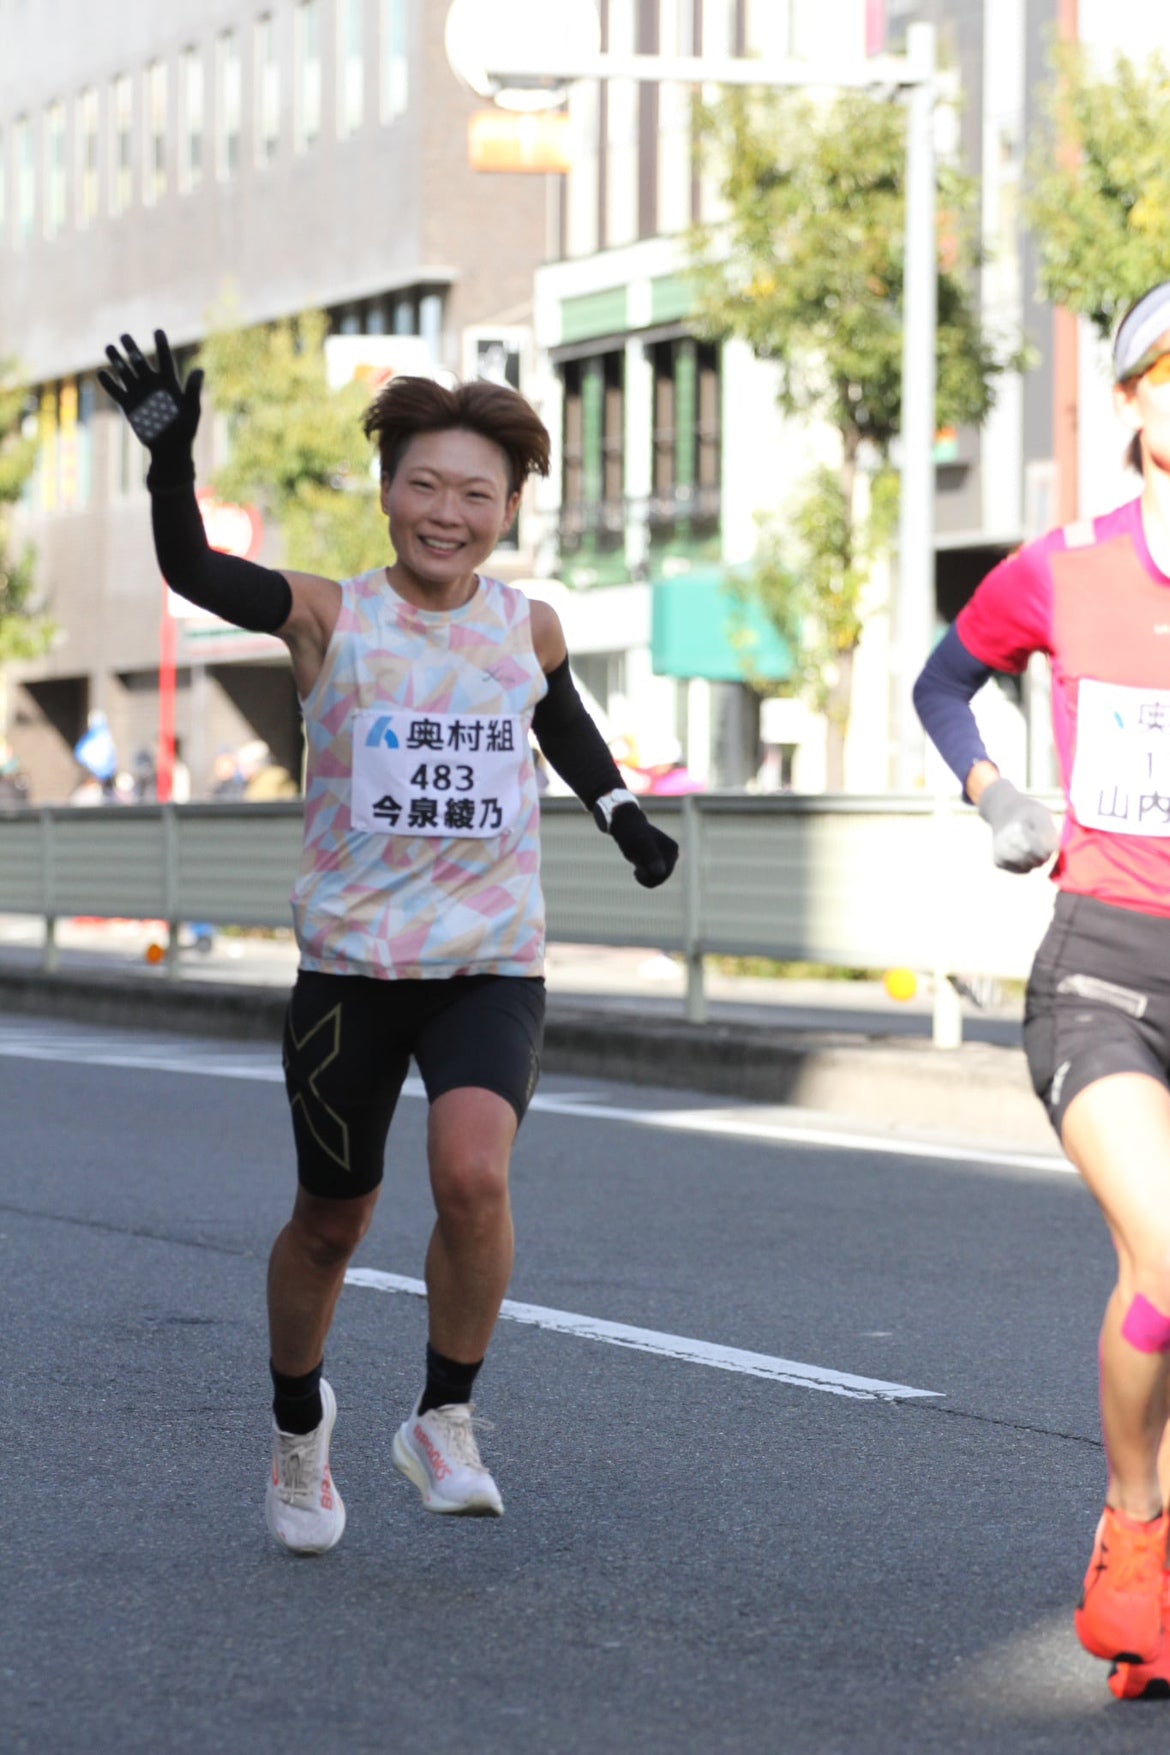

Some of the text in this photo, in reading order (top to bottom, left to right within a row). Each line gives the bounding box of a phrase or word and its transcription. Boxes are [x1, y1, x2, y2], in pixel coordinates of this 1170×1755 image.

[406, 718, 515, 751] 奥村組
[410, 763, 474, 792] 483
[372, 795, 503, 829] 今泉綾乃
